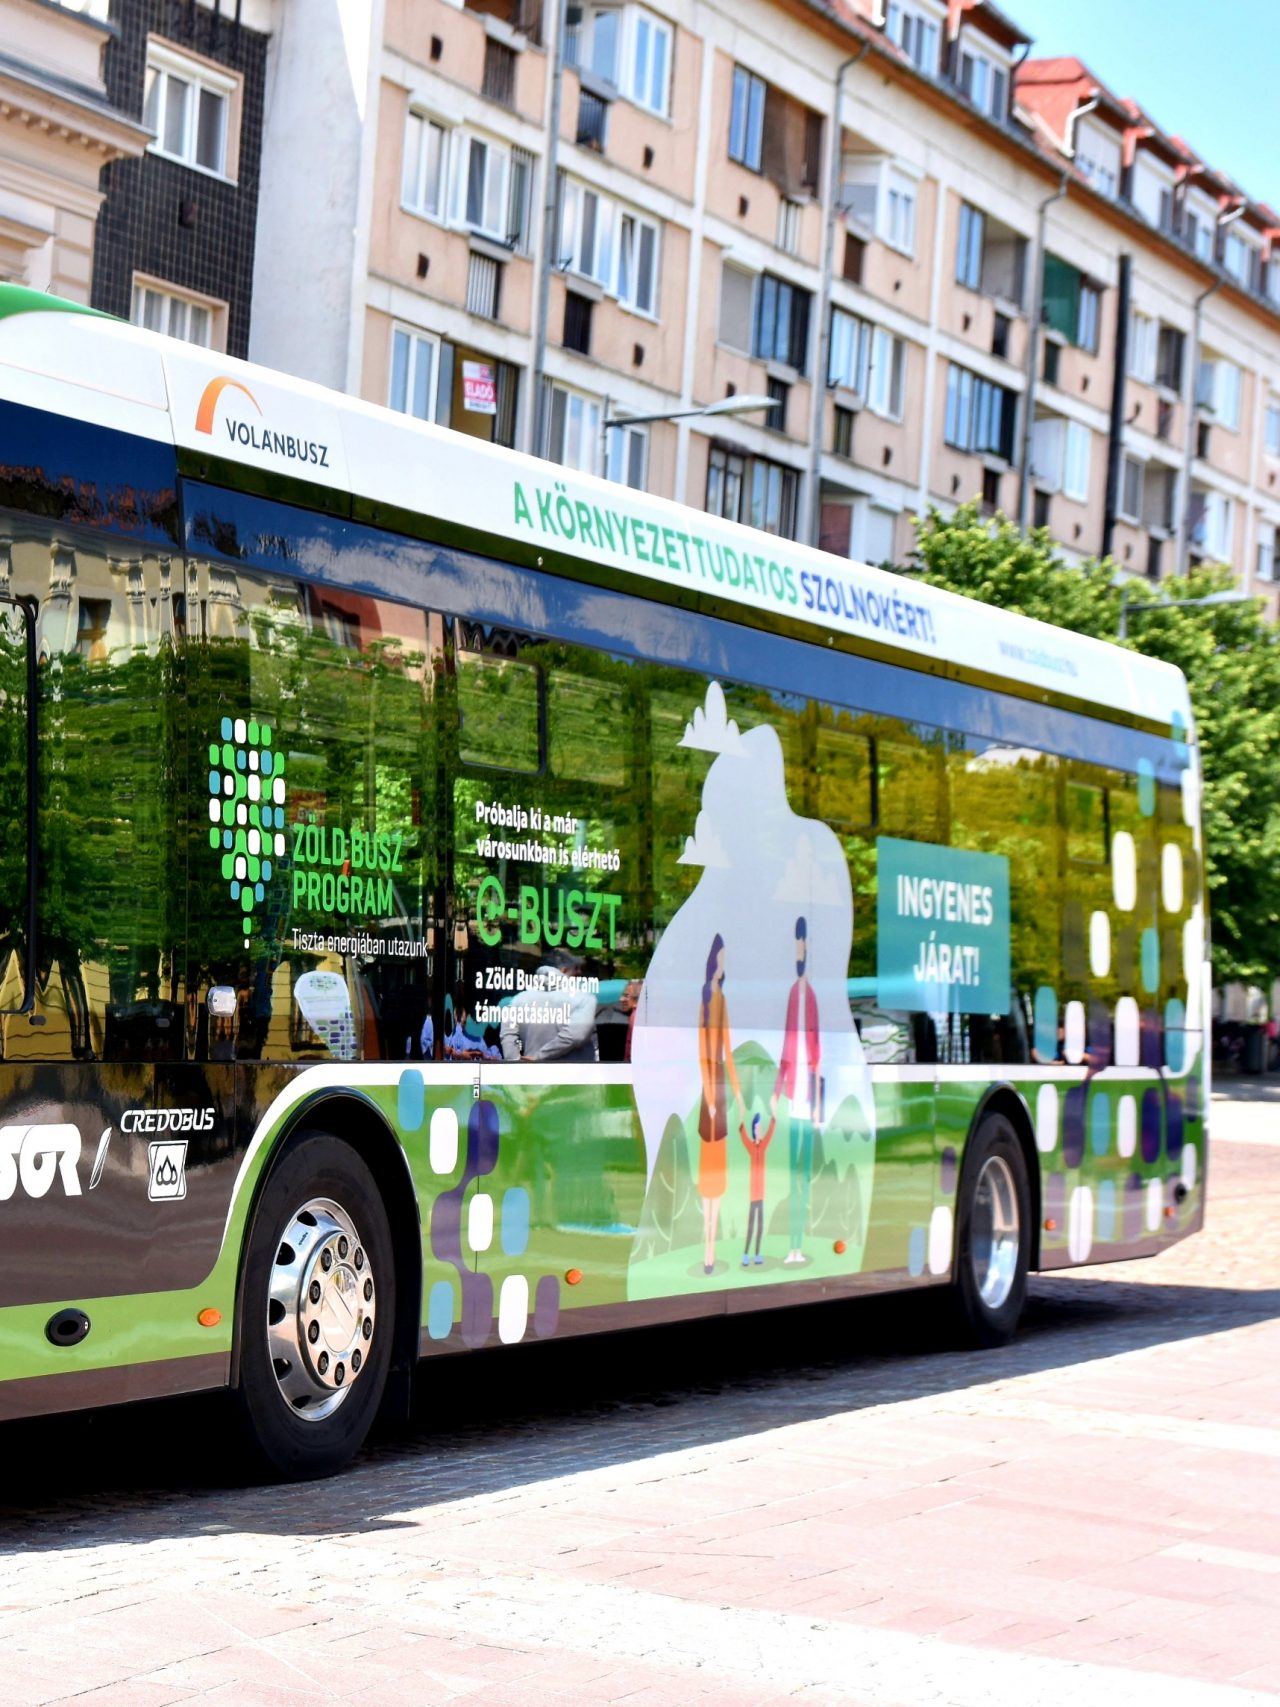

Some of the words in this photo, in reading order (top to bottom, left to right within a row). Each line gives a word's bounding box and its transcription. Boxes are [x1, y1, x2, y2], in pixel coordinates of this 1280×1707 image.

[225, 418, 329, 468] VOLÁNBUSZ
[513, 480, 535, 529] A
[535, 482, 799, 606] KÖRNYEZETTUDATOS
[799, 570, 937, 645] SZOLNOKÉRT!
[475, 800, 529, 835] Próbalja
[530, 807, 542, 830] ki
[543, 816, 551, 832] a
[553, 811, 578, 835] már
[292, 813, 346, 866] ZÖLD
[351, 830, 403, 872] BUSZ
[476, 834, 557, 865] városunkban
[559, 845, 570, 866] is
[571, 846, 621, 872] elérhető
[292, 870, 394, 917] PROGRAM
[896, 874, 994, 927] INGYENES
[291, 928, 325, 951] Tiszta
[327, 930, 386, 960] energiában
[388, 936, 428, 958] utazunk
[913, 930, 980, 987] JÁRAT!
[475, 972, 483, 989] a
[485, 966, 515, 990] Zöld
[516, 968, 546, 991] Busz
[548, 972, 600, 997] Program
[475, 999, 571, 1029] támogatásával!
[120, 1107, 216, 1133] CREDOBUS
